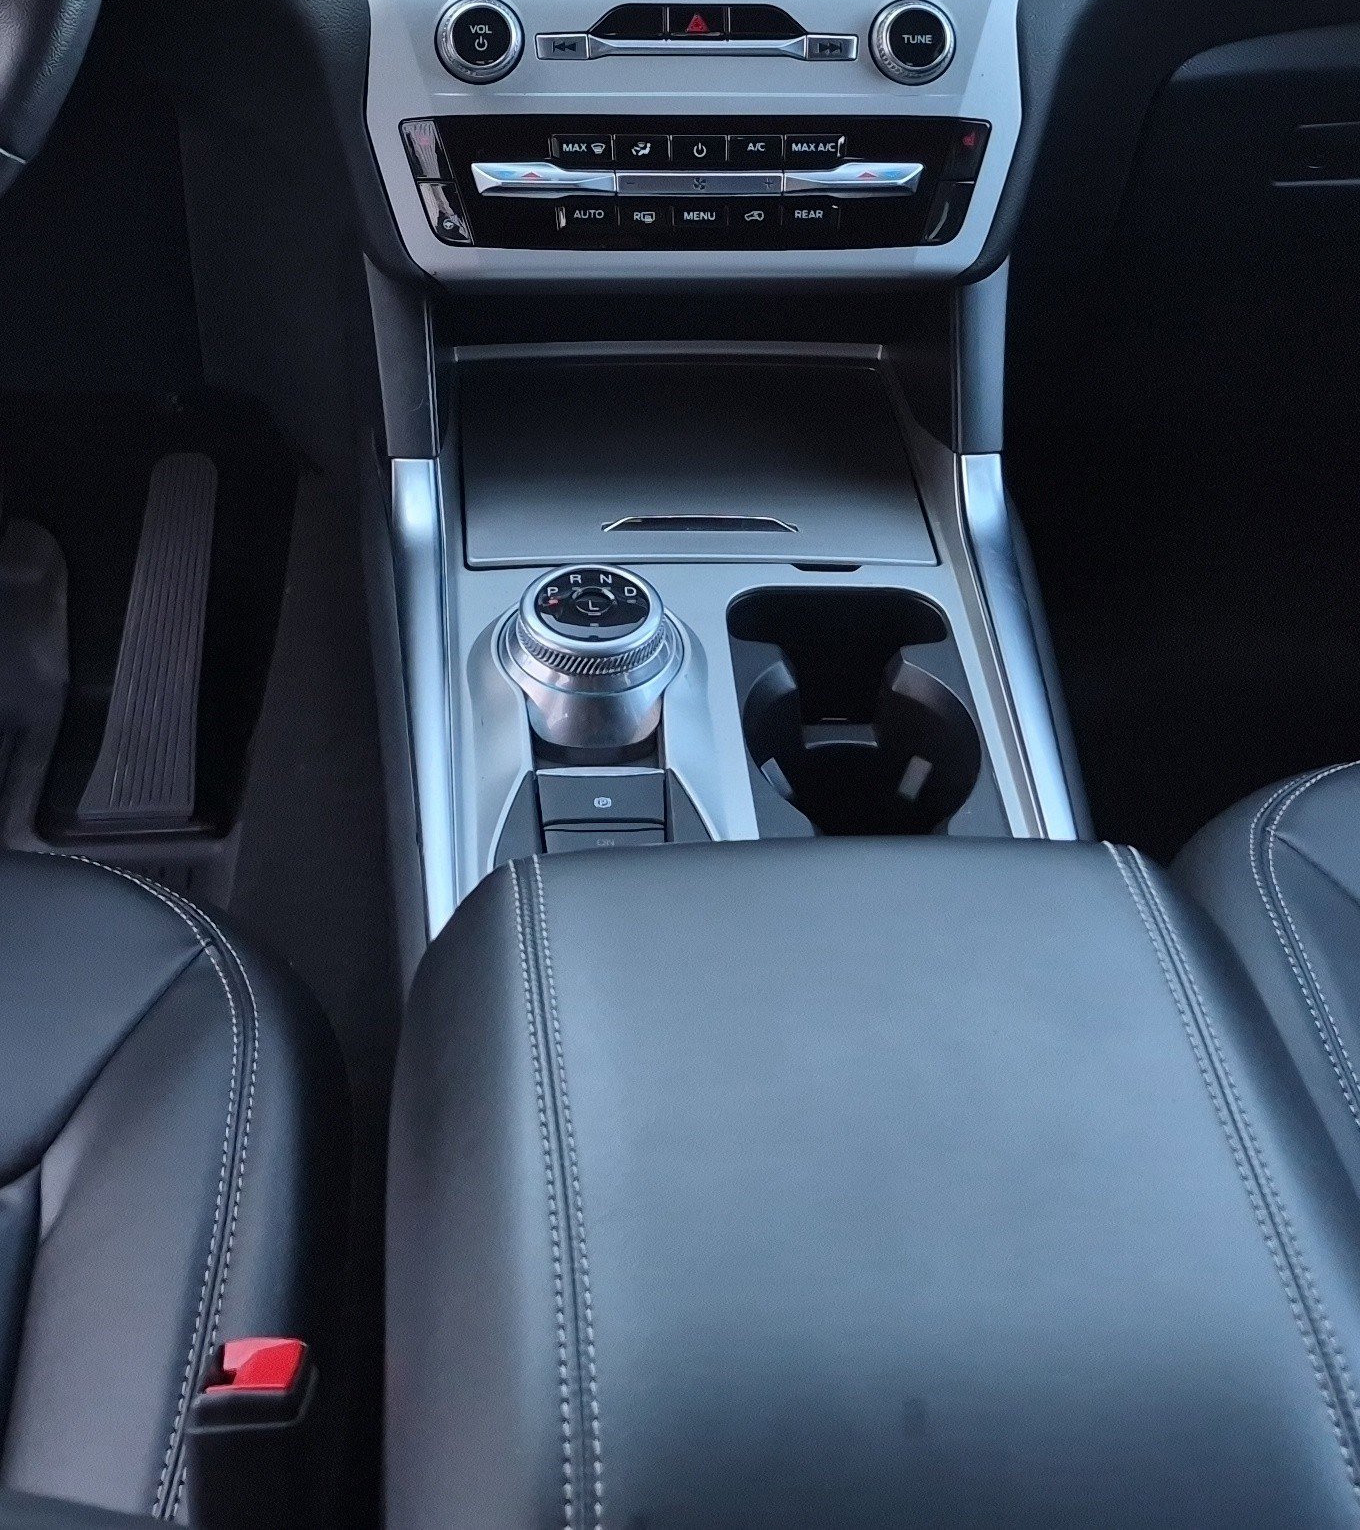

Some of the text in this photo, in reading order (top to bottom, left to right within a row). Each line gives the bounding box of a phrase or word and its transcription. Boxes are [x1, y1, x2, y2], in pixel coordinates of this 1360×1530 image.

[469, 24, 493, 34] VOL
[901, 34, 933, 44] TUNE
[562, 142, 588, 152] MAX
[747, 142, 766, 152] A/C
[791, 142, 836, 152] MAX A/C
[573, 209, 605, 219] AUTO
[683, 211, 716, 221] MENU
[794, 210, 824, 220] REAR
[547, 574, 637, 597] P R N D
[588, 600, 600, 611] L
